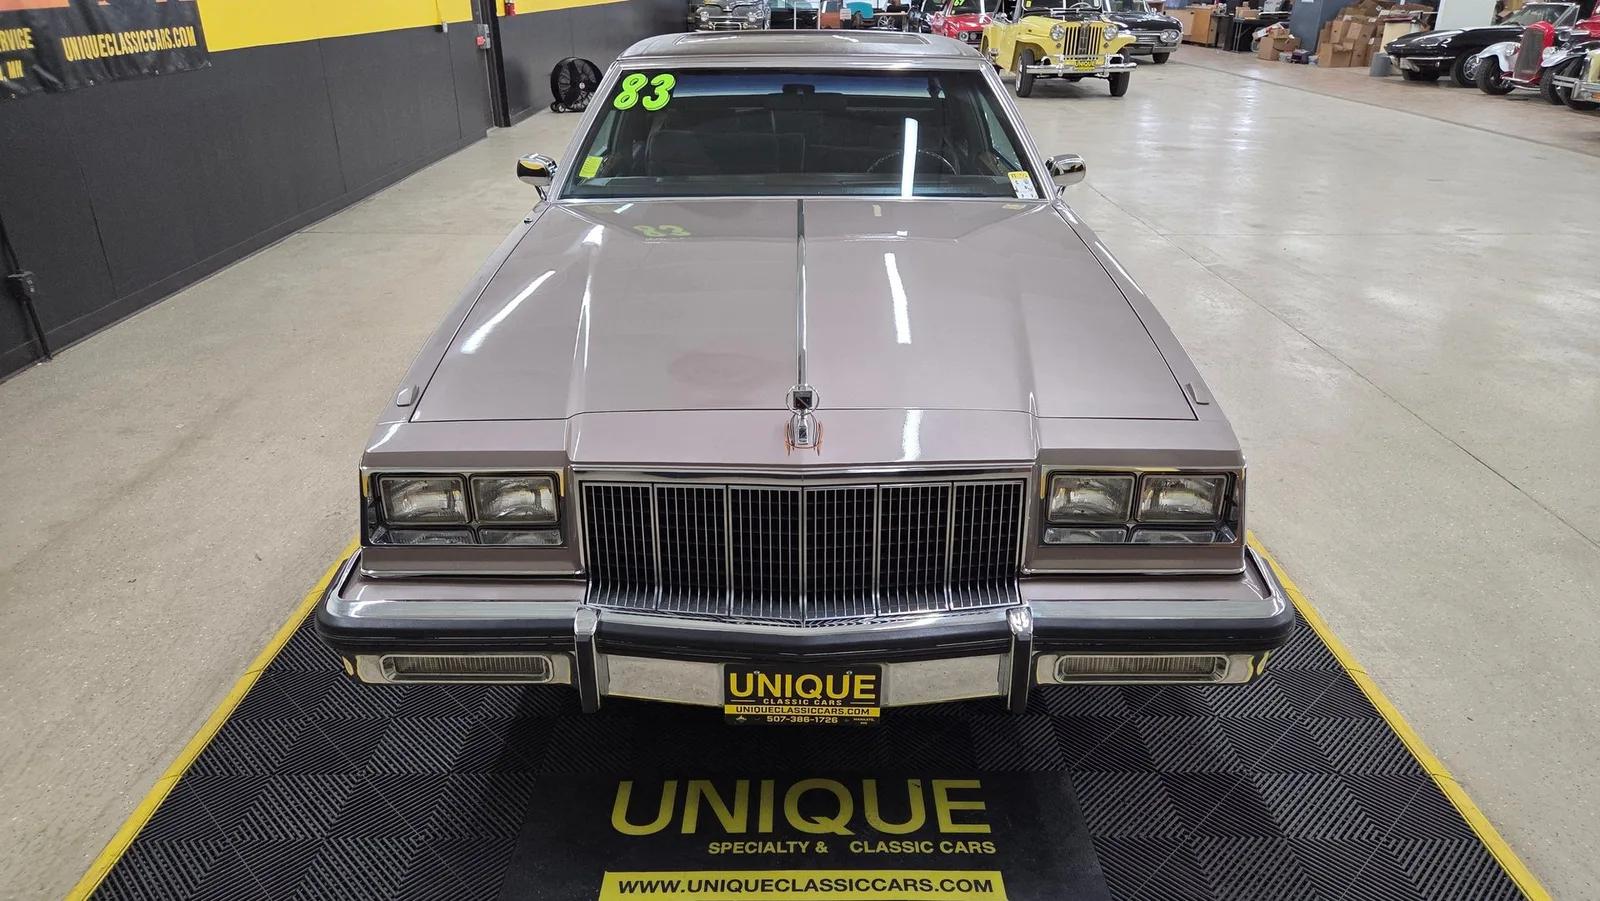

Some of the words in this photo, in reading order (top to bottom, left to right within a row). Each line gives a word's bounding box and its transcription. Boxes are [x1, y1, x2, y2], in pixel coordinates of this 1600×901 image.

[61, 26, 197, 62] UNIQUECLASSICCARS.COM
[613, 73, 676, 111] 83
[729, 672, 876, 700] UNIQUE
[735, 706, 870, 715] UNIQUECLASSICCARS.COM
[611, 778, 992, 835] UNIQUE
[708, 841, 809, 854] SPECIALTY
[815, 841, 828, 853] &
[850, 841, 934, 853] CLASSIC
[939, 841, 996, 854] CARS
[618, 878, 994, 893] WWW.UNIQUECLASSICCARS.COM
